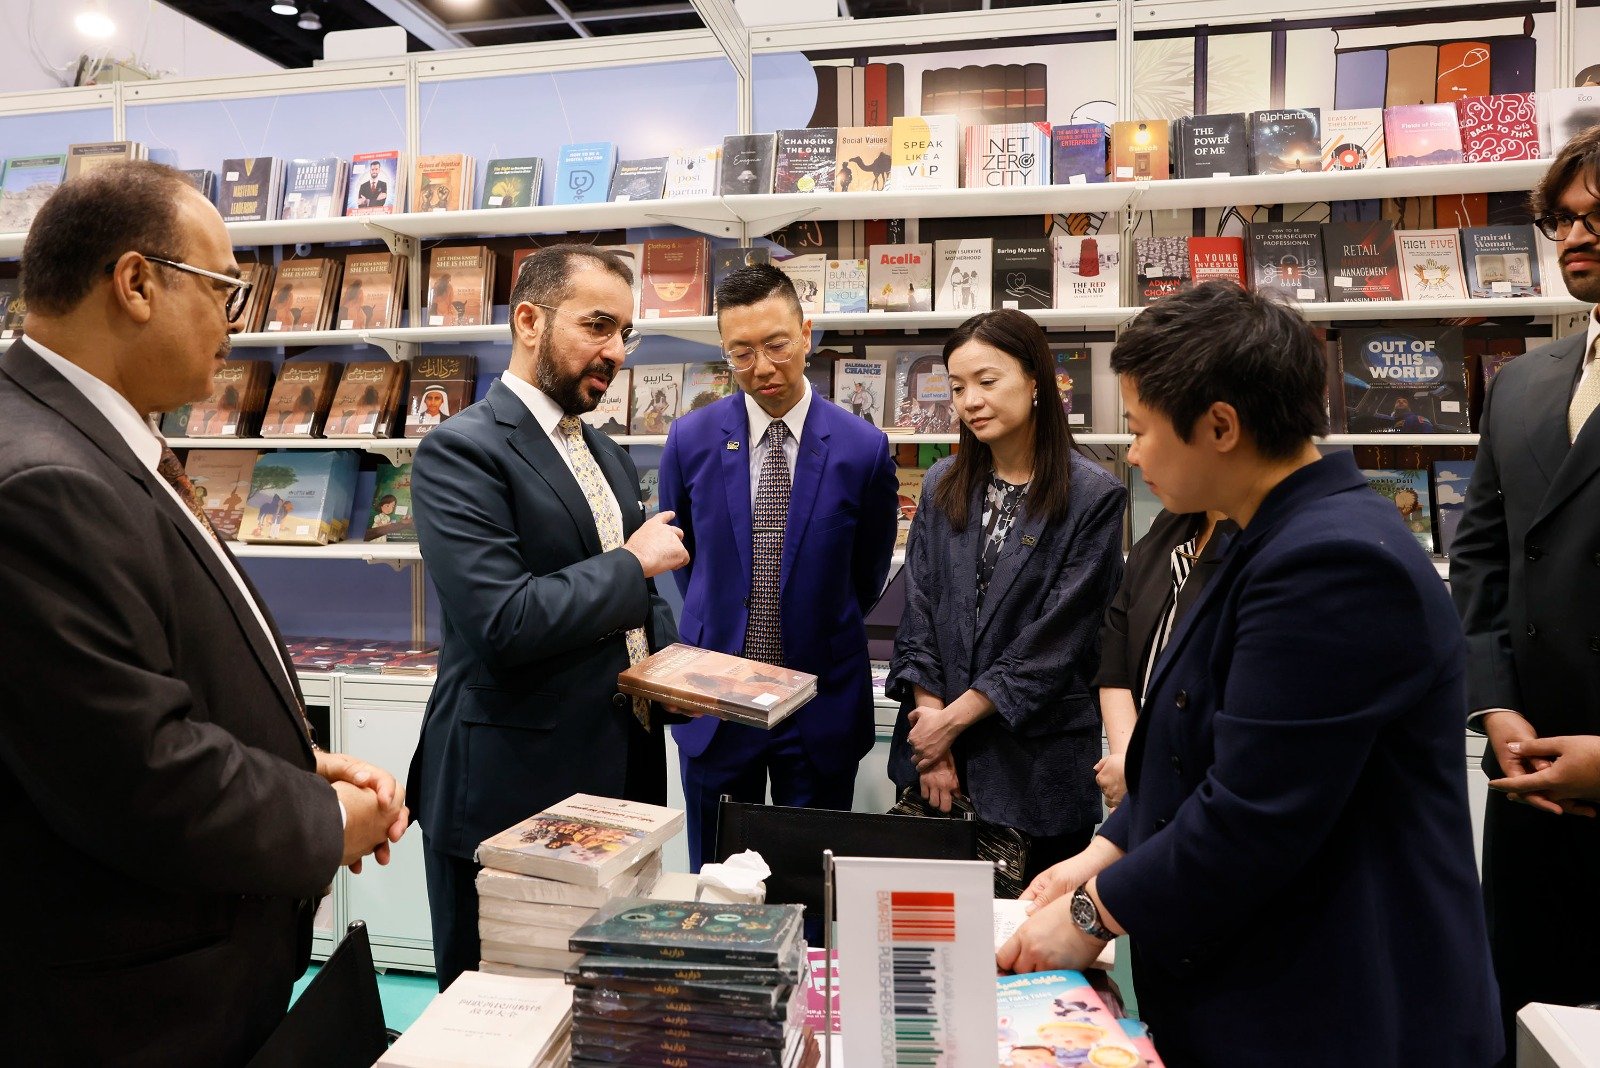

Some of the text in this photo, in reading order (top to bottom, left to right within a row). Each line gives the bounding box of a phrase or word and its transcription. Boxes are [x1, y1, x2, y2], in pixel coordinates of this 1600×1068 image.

[1194, 128, 1214, 136] THE
[1470, 124, 1534, 138] BACK TO THAT
[904, 140, 943, 150] SPEAK
[989, 137, 1030, 154] NET
[1194, 136, 1230, 145] POWER
[1195, 146, 1226, 156] OF ME
[676, 156, 706, 166] this is
[982, 152, 1035, 172] ZERO
[677, 174, 700, 184] post
[986, 169, 1032, 187] CITY
[668, 188, 709, 198] partum
[1473, 232, 1511, 240] Emirati
[1402, 239, 1454, 249] HIGH FIVE
[998, 248, 1017, 256] Baring
[1344, 244, 1380, 257] RETAIL
[1194, 253, 1238, 262] A YOUNG
[829, 270, 866, 282] BUILD A
[1340, 266, 1388, 278] MANAGEMENT
[828, 281, 865, 290] BETTER
[1149, 280, 1180, 288] ADMAN
[835, 292, 858, 300] YOU
[1368, 340, 1436, 353] OUT OF
[1382, 353, 1424, 366] THIS
[845, 367, 881, 376] CHANCE
[1369, 366, 1439, 379] WORLD
[643, 373, 672, 385] كاريبو
[876, 890, 892, 1016] EMIRATES PUBLISHERS
